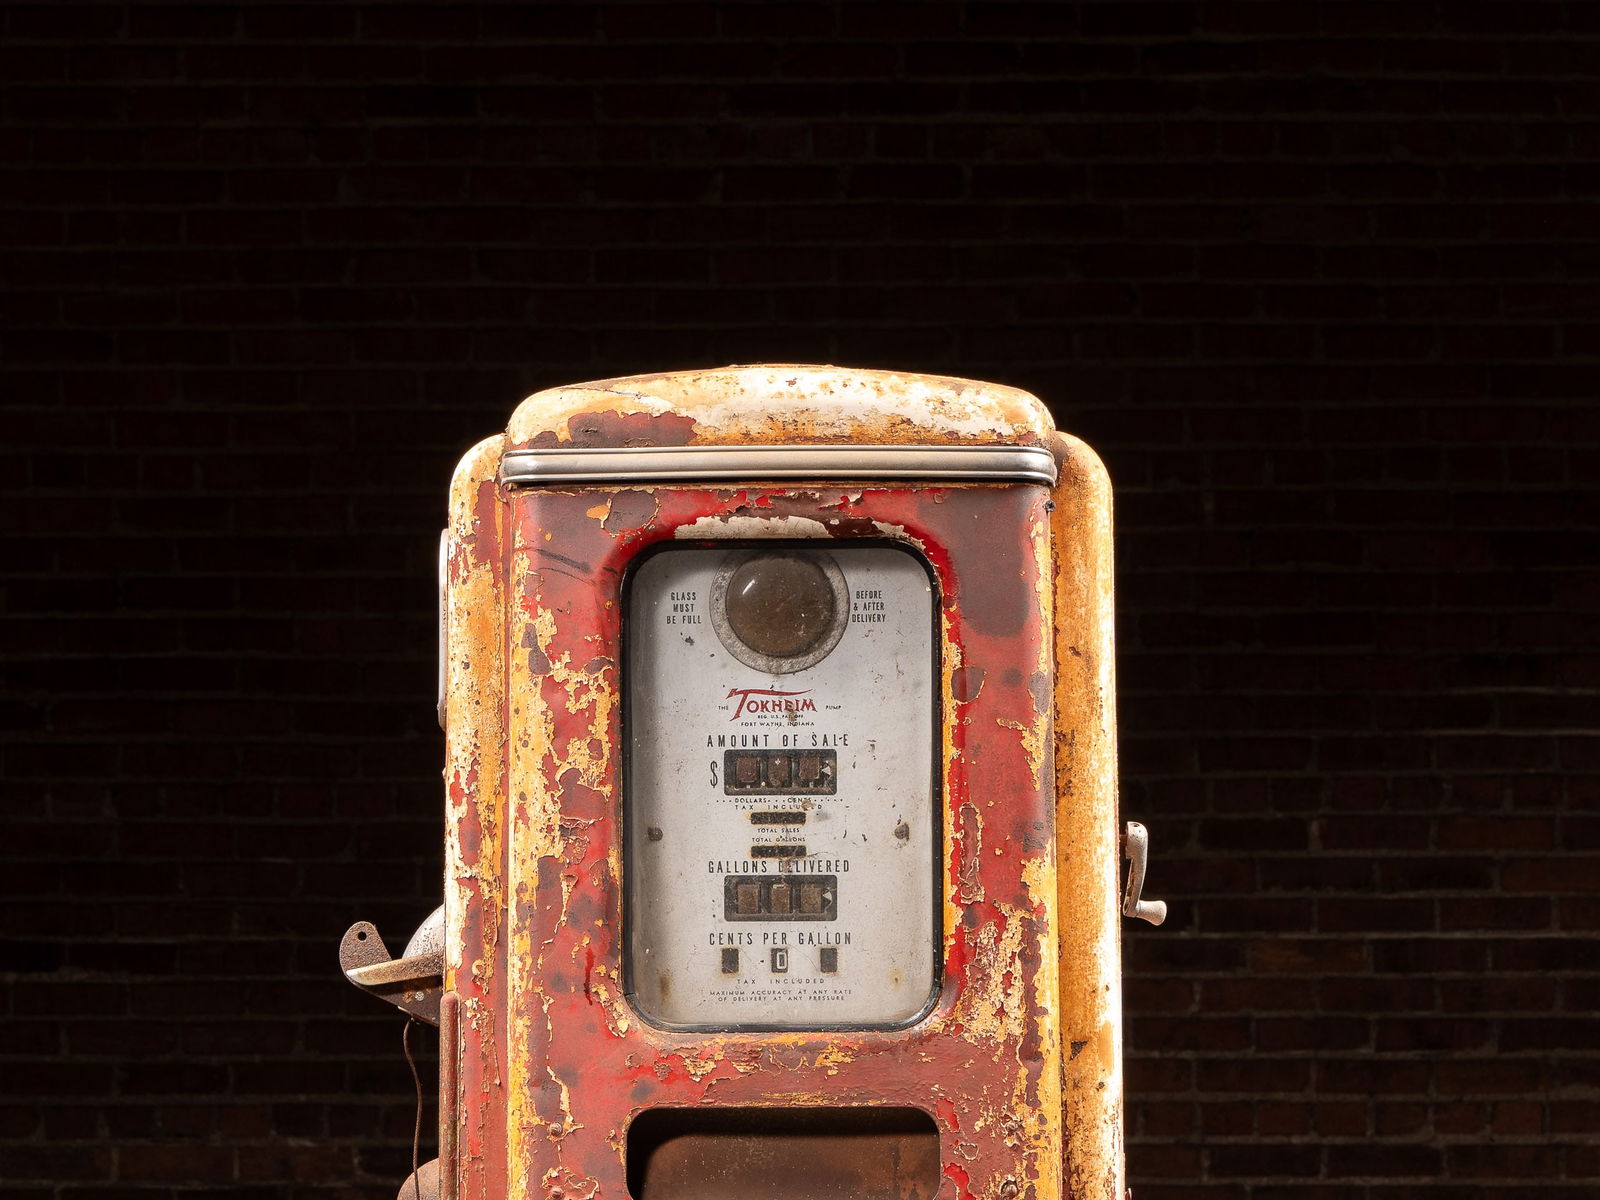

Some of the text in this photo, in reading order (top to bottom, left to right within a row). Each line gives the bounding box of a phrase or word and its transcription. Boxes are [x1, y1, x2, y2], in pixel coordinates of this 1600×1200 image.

[670, 591, 697, 601] GLASS
[855, 590, 882, 600] BEFORE
[672, 603, 694, 613] MUST
[853, 602, 885, 611] & AFTER
[666, 615, 702, 625] BE FULL
[851, 614, 887, 623] DELIVERY
[725, 688, 818, 722] TOKHEIM
[707, 733, 849, 748] AMOUNT OF SALE
[710, 760, 718, 789] $
[708, 860, 768, 874] GALLONS
[709, 932, 851, 946] CENTS PER GALLON
